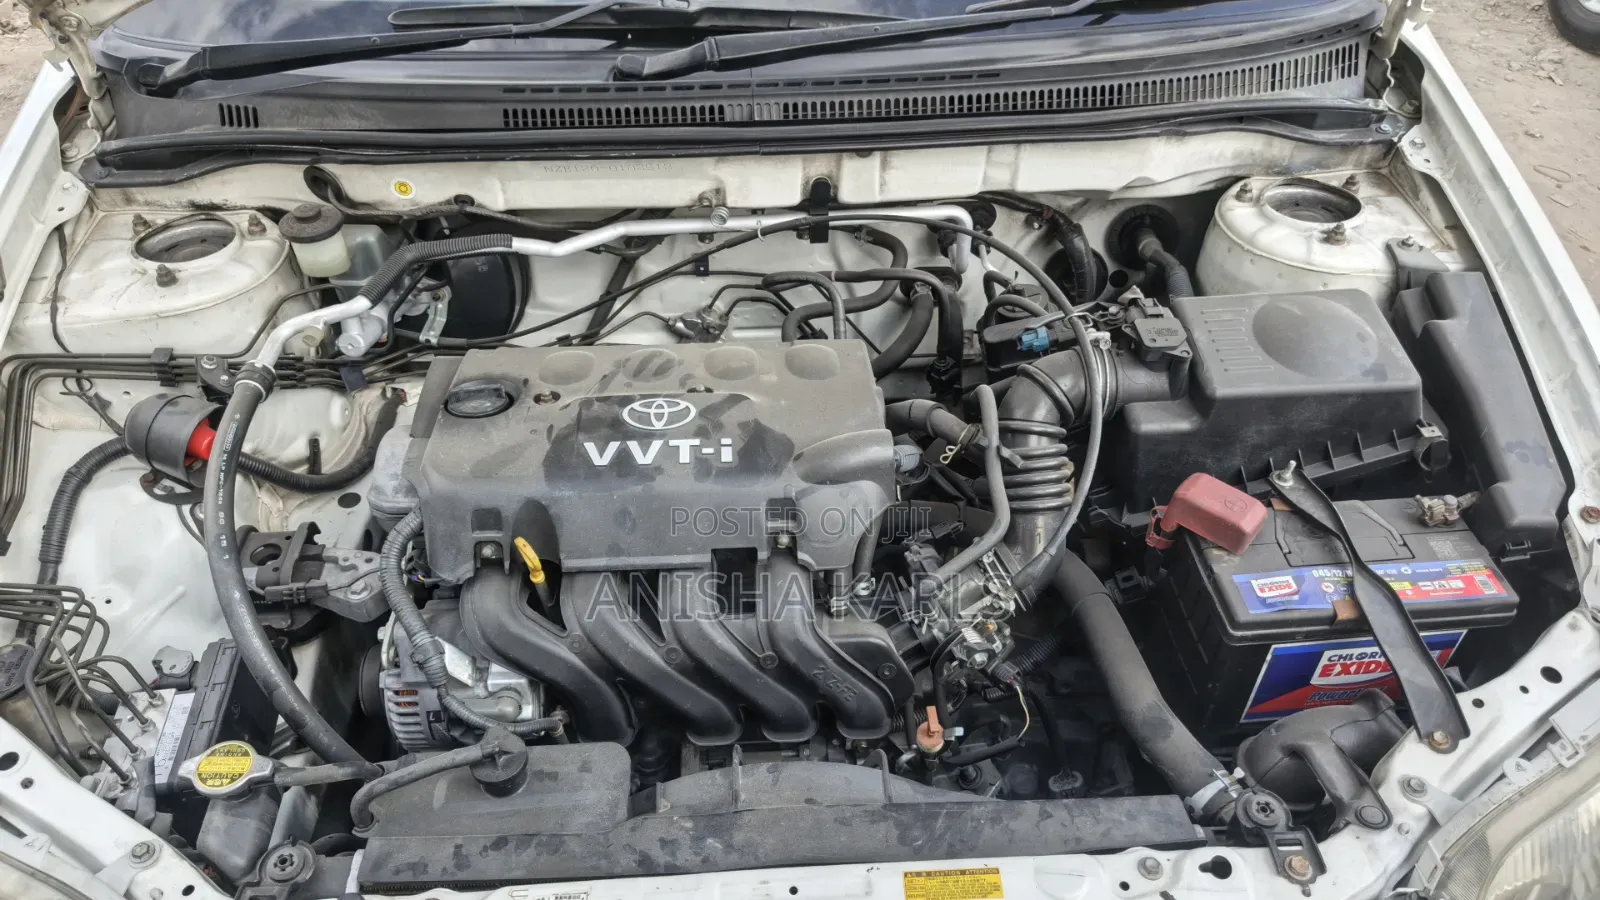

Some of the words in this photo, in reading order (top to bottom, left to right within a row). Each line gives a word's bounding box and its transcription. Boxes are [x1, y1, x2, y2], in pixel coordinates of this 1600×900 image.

[582, 437, 734, 467] VVT-i
[1258, 583, 1294, 593] EXIDE
[1327, 650, 1386, 663] CHLORI
